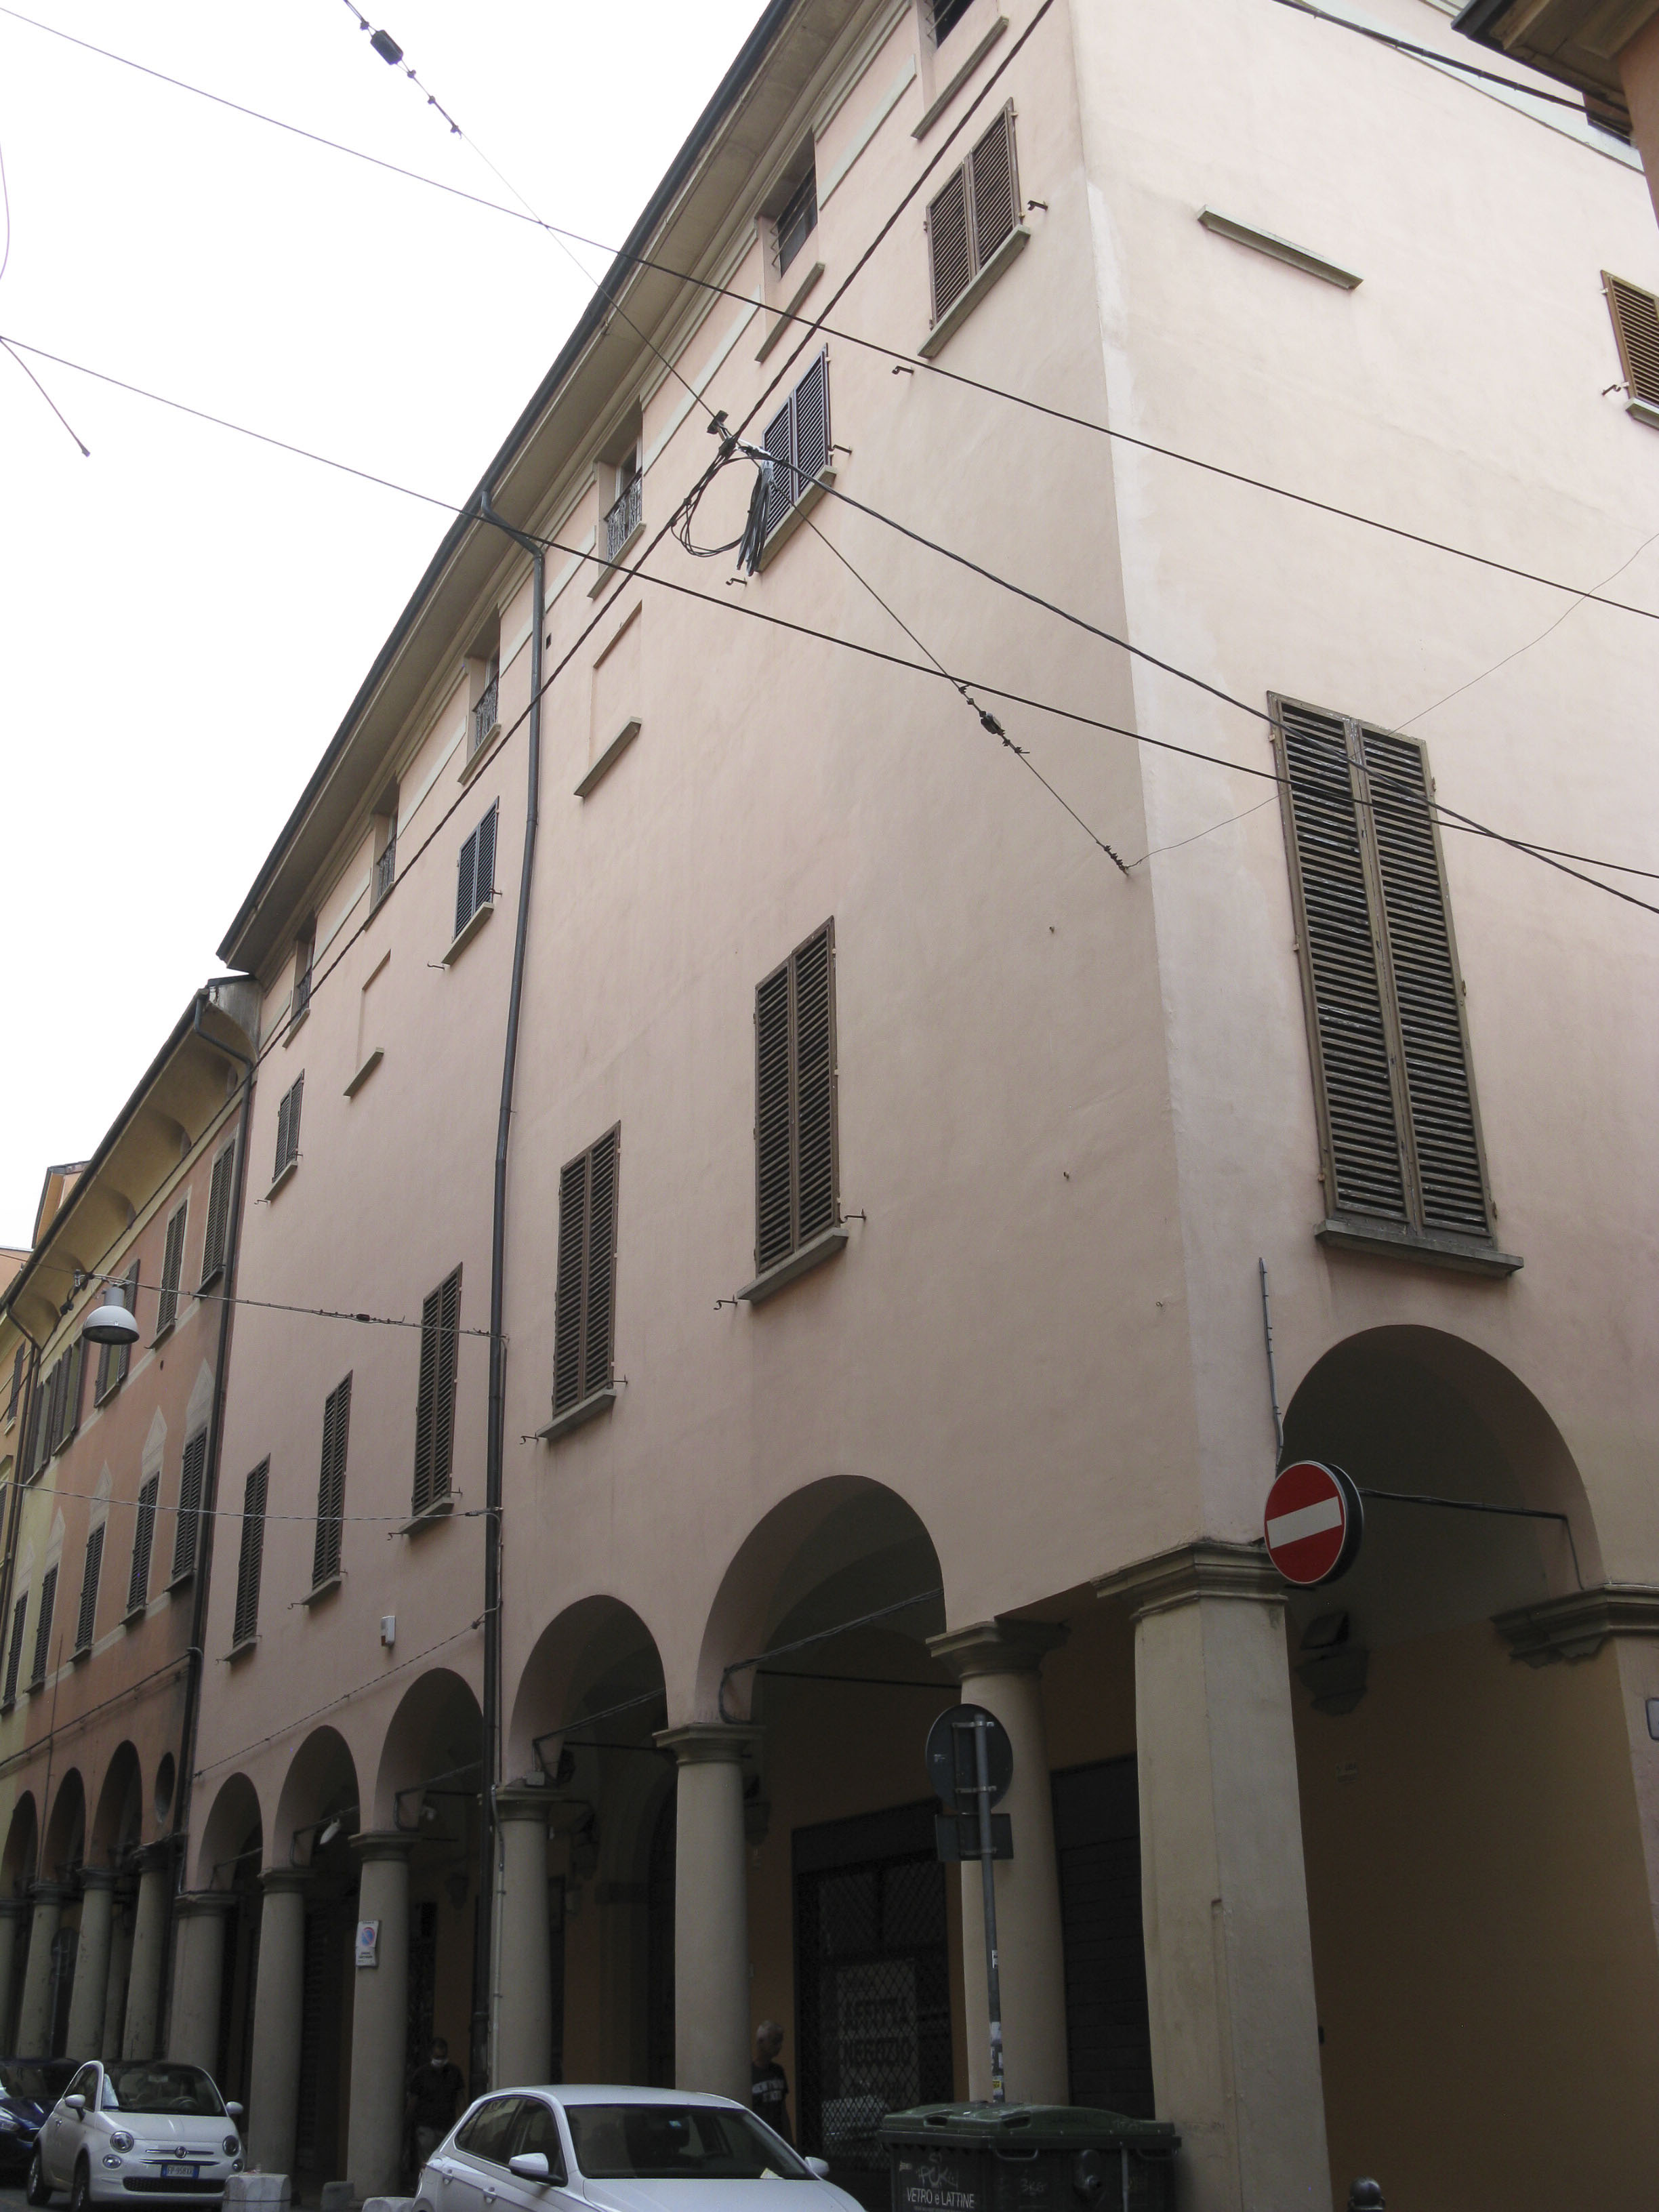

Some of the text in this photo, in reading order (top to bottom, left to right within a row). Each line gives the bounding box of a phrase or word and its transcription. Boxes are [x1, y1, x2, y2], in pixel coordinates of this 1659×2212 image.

[907, 2187, 975, 2209] VETRO e LATTINE
